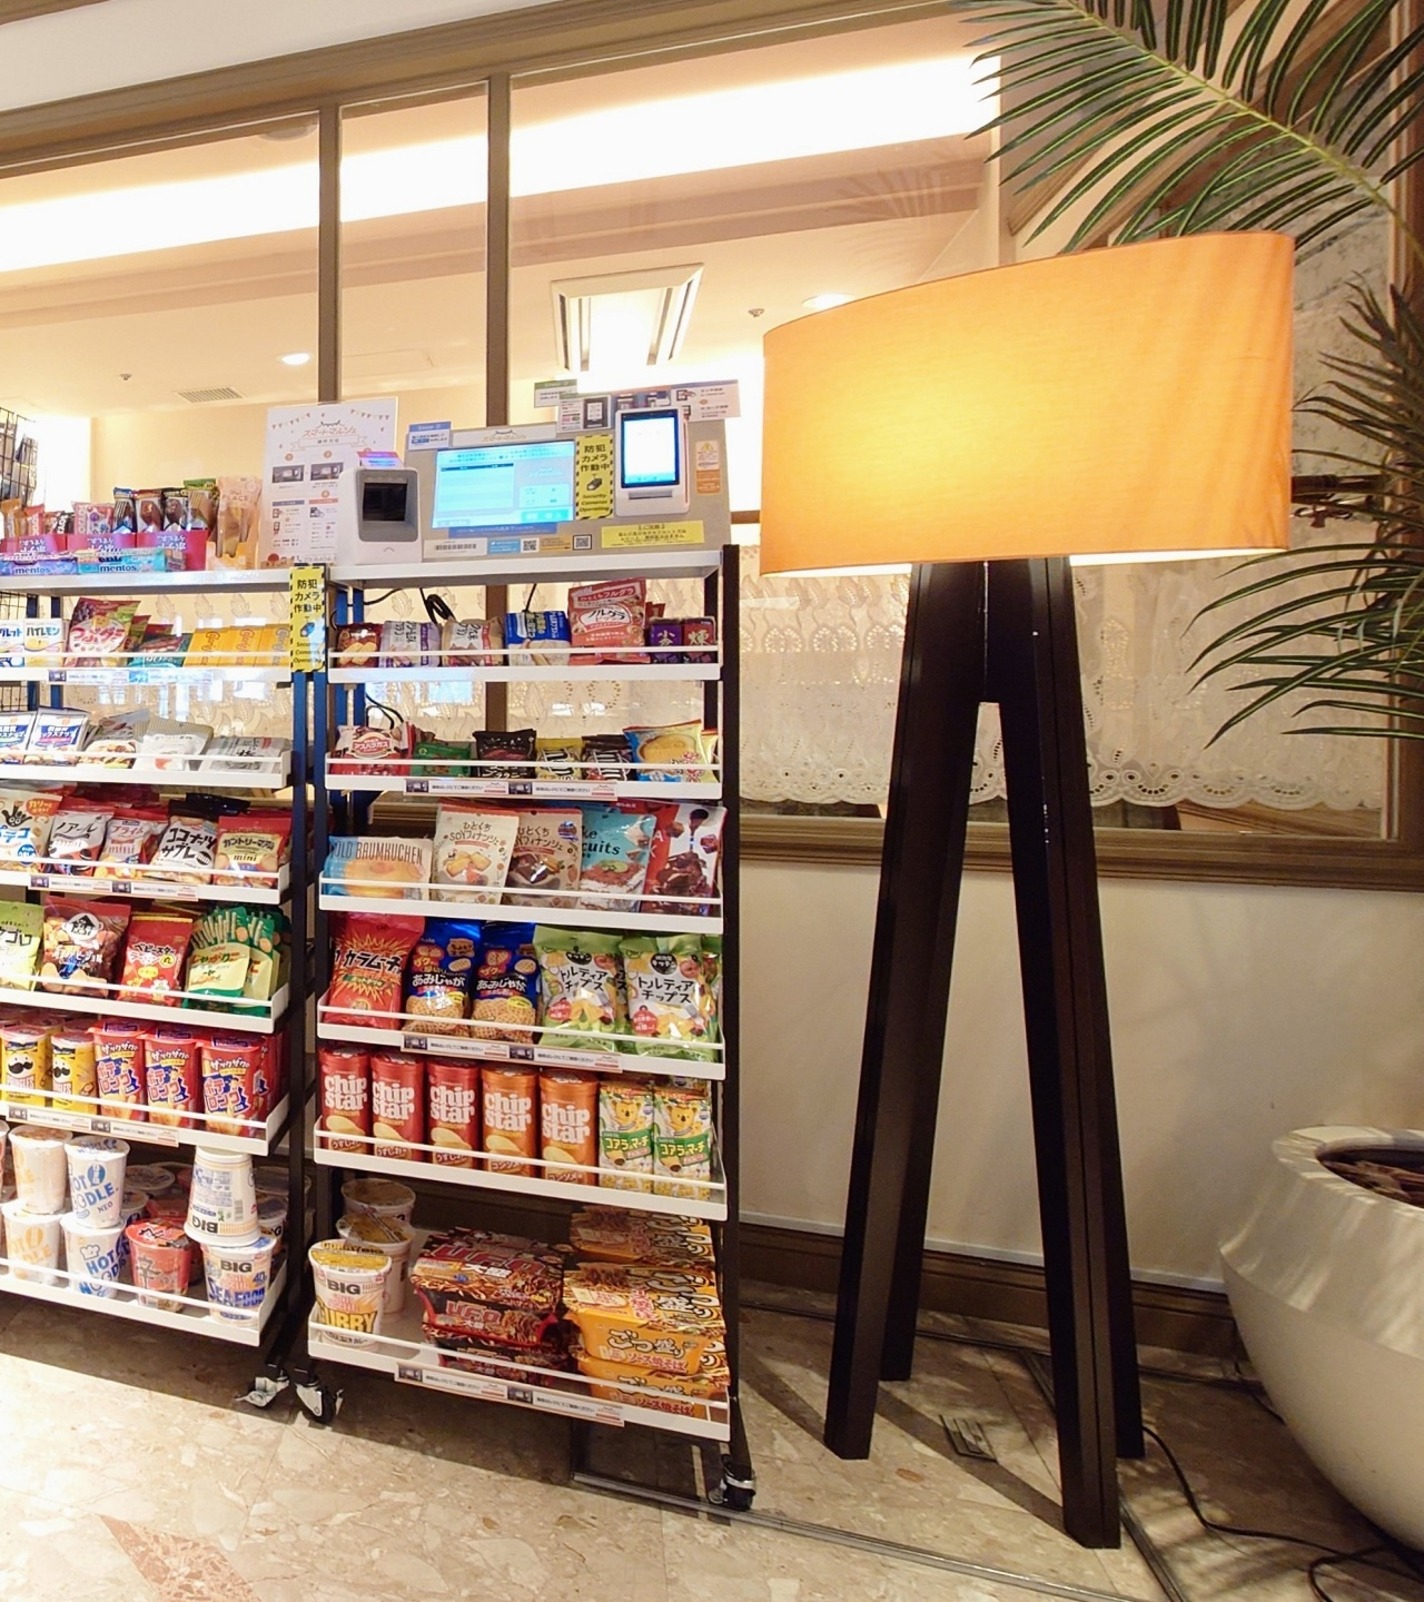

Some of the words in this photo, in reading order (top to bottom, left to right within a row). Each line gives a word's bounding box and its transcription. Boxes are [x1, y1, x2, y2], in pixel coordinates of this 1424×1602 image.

[584, 444, 606, 453] 防犯
[581, 454, 608, 463] カメラ
[580, 463, 610, 472] 作動中
[99, 565, 137, 573] mentos
[297, 579, 318, 589] 防犯
[294, 591, 320, 601] カメラ
[293, 603, 322, 613] 作動中
[26, 626, 61, 637] ハイレモン
[56, 820, 98, 834] ノアール
[463, 822, 492, 832] ひとくち
[166, 827, 218, 850] ココナッツ
[222, 837, 276, 850] カントリーマアム
[449, 830, 499, 847] SOYフィナンシェ
[161, 843, 196, 860] サブレ
[233, 853, 258, 862] mini
[355, 841, 424, 865] BAUMKUCHEN
[133, 941, 175, 955] ベビースター
[412, 973, 465, 987] あみじゃが
[560, 966, 608, 982] トルティア
[476, 978, 527, 992] あみじゃが
[564, 978, 605, 994] チップス
[638, 976, 695, 991] トルティア
[641, 989, 693, 1004] チップス
[325, 1075, 367, 1095] chip
[372, 1081, 415, 1104] chip
[325, 1092, 368, 1111] star
[430, 1086, 475, 1109] chip
[484, 1092, 533, 1114] chip
[372, 1099, 415, 1120] star
[430, 1102, 475, 1124] star
[542, 1103, 590, 1127] chip
[484, 1109, 533, 1132] star
[542, 1122, 591, 1144] star
[606, 1136, 649, 1150] コアラのマーチ
[661, 1143, 705, 1157] コアラのマーチ
[98, 1201, 114, 1213] NEO
[191, 1215, 219, 1234] BIG
[86, 1251, 117, 1275] HOT
[220, 1260, 253, 1273] BIG
[327, 1279, 362, 1296] BIG
[607, 1328, 686, 1359] ごつ盛り
[627, 1352, 688, 1374] ソース焼そば
